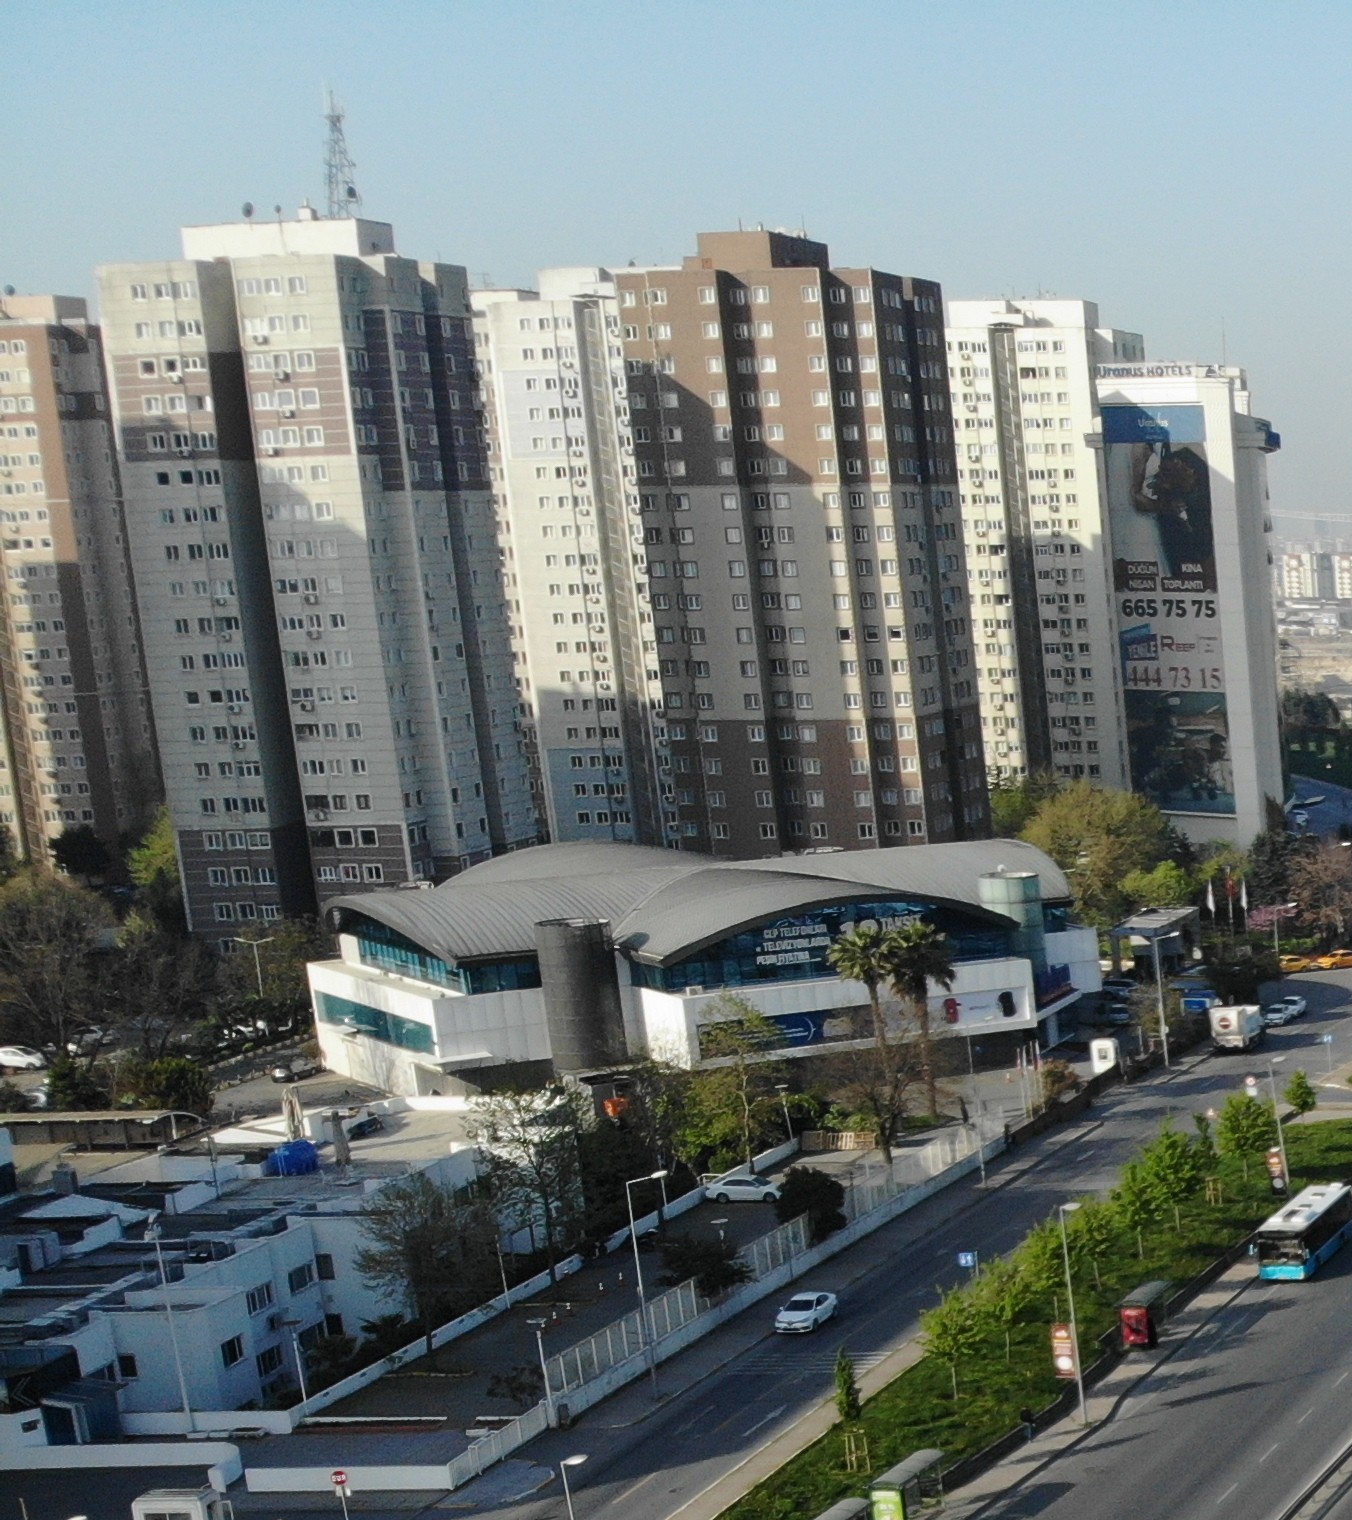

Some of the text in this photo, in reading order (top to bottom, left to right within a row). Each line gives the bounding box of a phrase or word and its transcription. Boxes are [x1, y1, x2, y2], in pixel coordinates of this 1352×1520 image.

[1146, 365, 1192, 378] HOTELS
[1163, 580, 1204, 590] TOPLANTI
[1122, 599, 1216, 618] 665 75 75
[1128, 666, 1221, 689] 444 73 15
